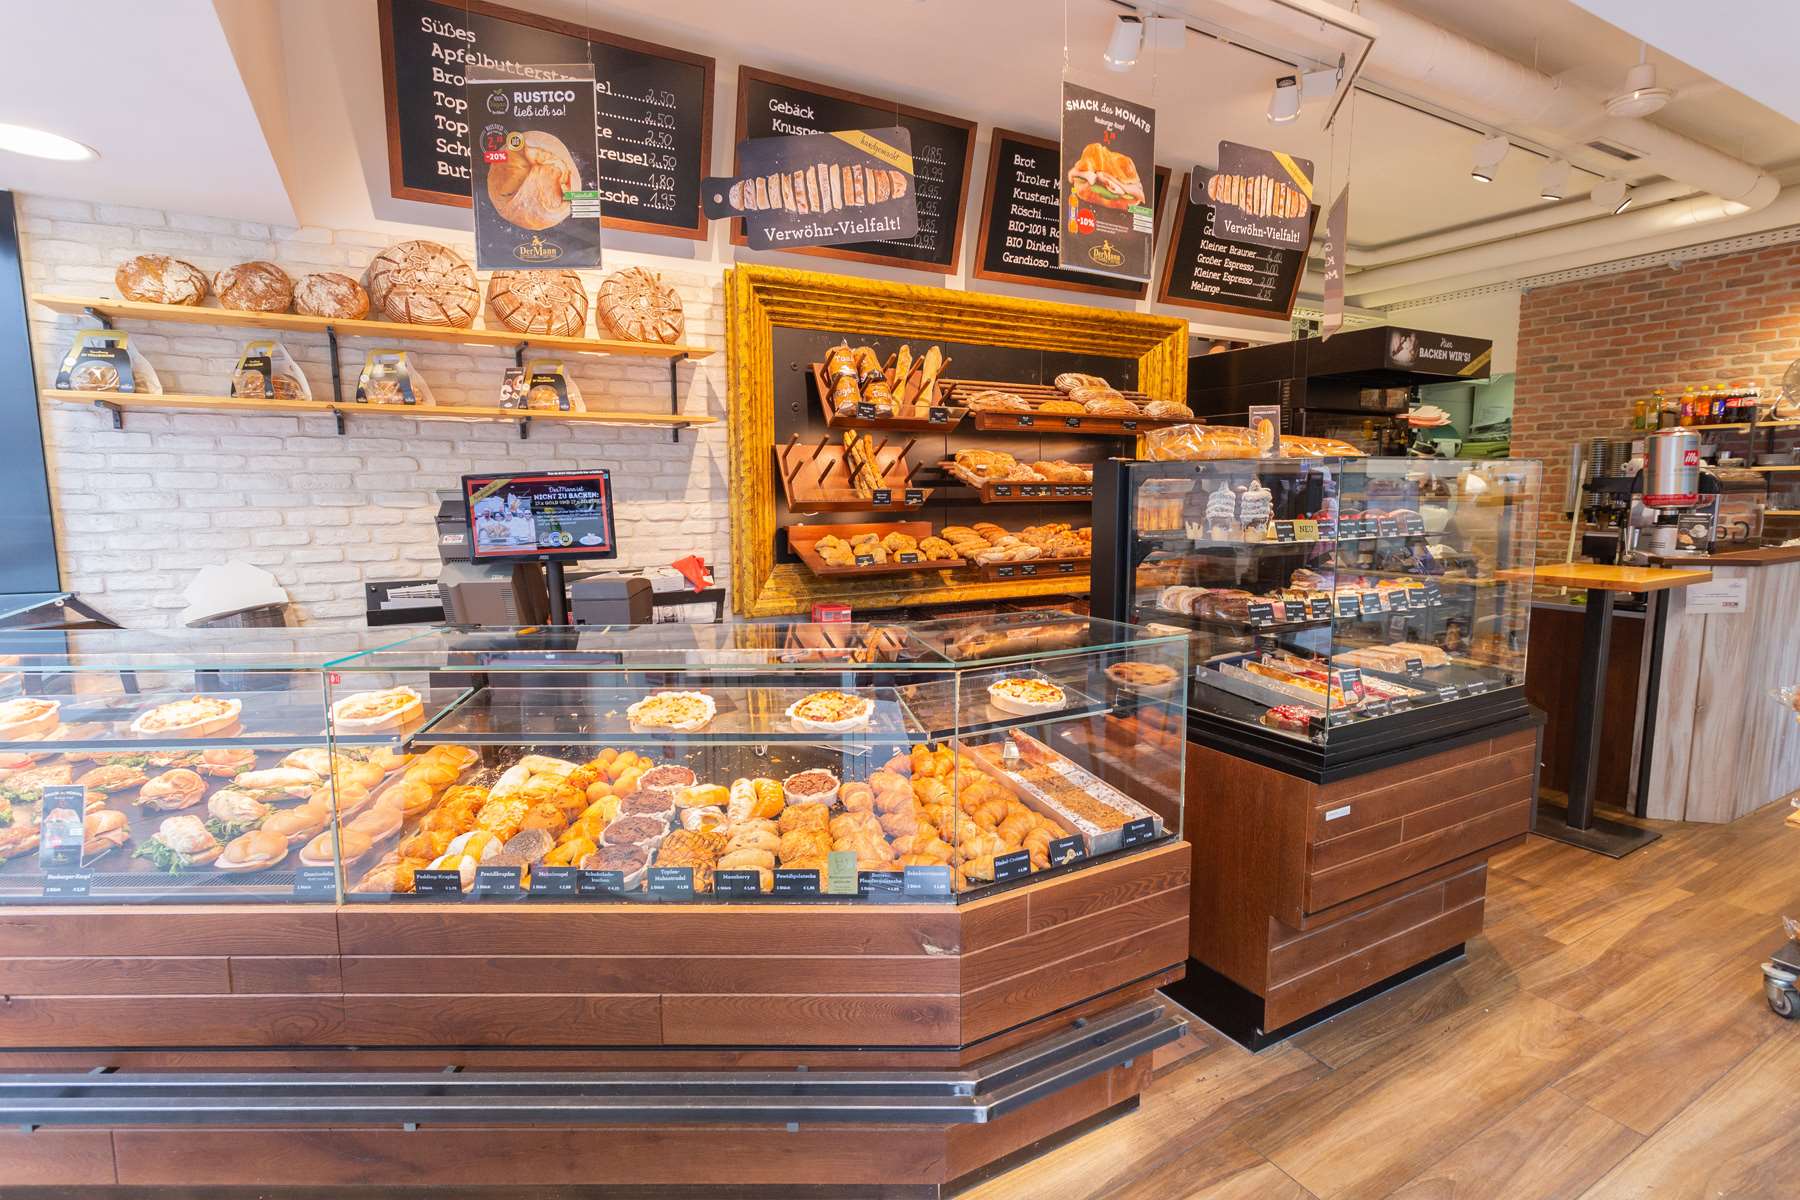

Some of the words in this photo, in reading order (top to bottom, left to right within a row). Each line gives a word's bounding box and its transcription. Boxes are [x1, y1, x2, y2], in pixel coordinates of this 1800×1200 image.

[421, 16, 476, 43] Süßes
[432, 67, 468, 87] Bro
[513, 90, 576, 103] RUSTICO
[769, 99, 815, 120] Gebäck
[1065, 99, 1099, 111] SNACK
[1115, 106, 1151, 133] MONATS
[1013, 154, 1036, 168] Brot
[1016, 171, 1051, 188] Tiroler
[1010, 204, 1042, 219] Röschi
[764, 217, 901, 241] Verwöhn-Vielfalt!
[1224, 219, 1300, 243] Verwöhn-Vielfalt!
[1006, 236, 1023, 249] BIO
[1200, 239, 1228, 253] Kleiner
[1229, 245, 1257, 259] Brauner
[1002, 252, 1049, 268] Grandioso
[1197, 253, 1222, 266] Großer
[1224, 259, 1254, 271] Espresso
[1194, 267, 1221, 280] Kleiner
[1222, 272, 1253, 285] Espresso
[1190, 280, 1221, 296] Melange
[1419, 347, 1448, 361] BACKEN
